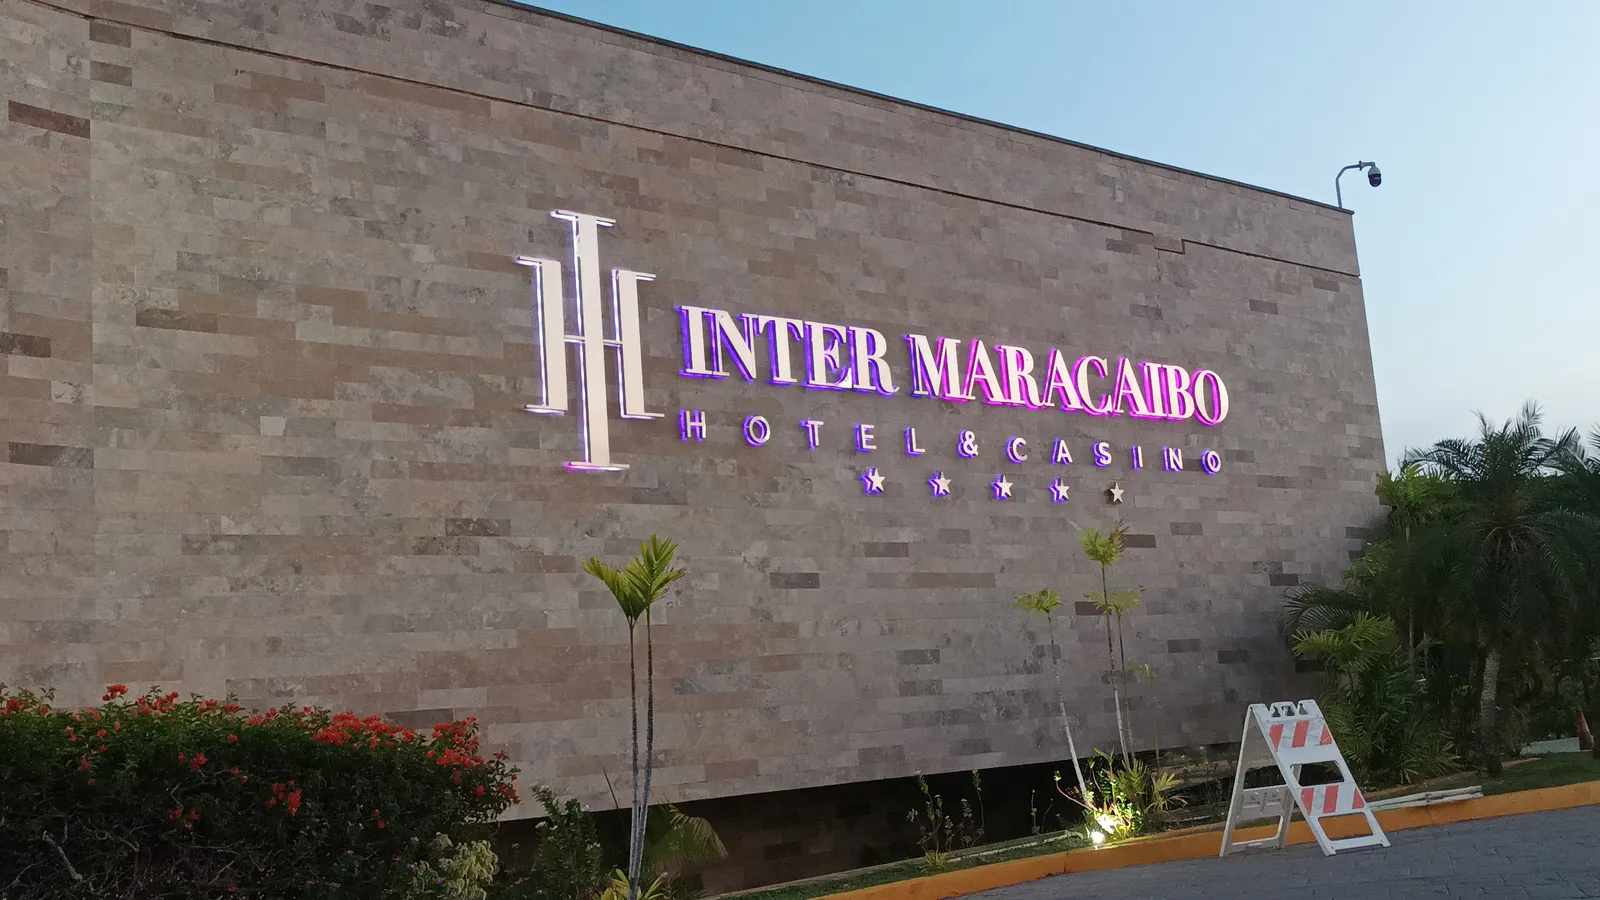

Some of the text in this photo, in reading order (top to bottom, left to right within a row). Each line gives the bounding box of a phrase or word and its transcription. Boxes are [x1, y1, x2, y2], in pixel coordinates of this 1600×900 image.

[676, 304, 1230, 426] INTER MARACAIBO
[679, 409, 926, 456] HOTEL
[1005, 436, 1222, 476] CASINO
